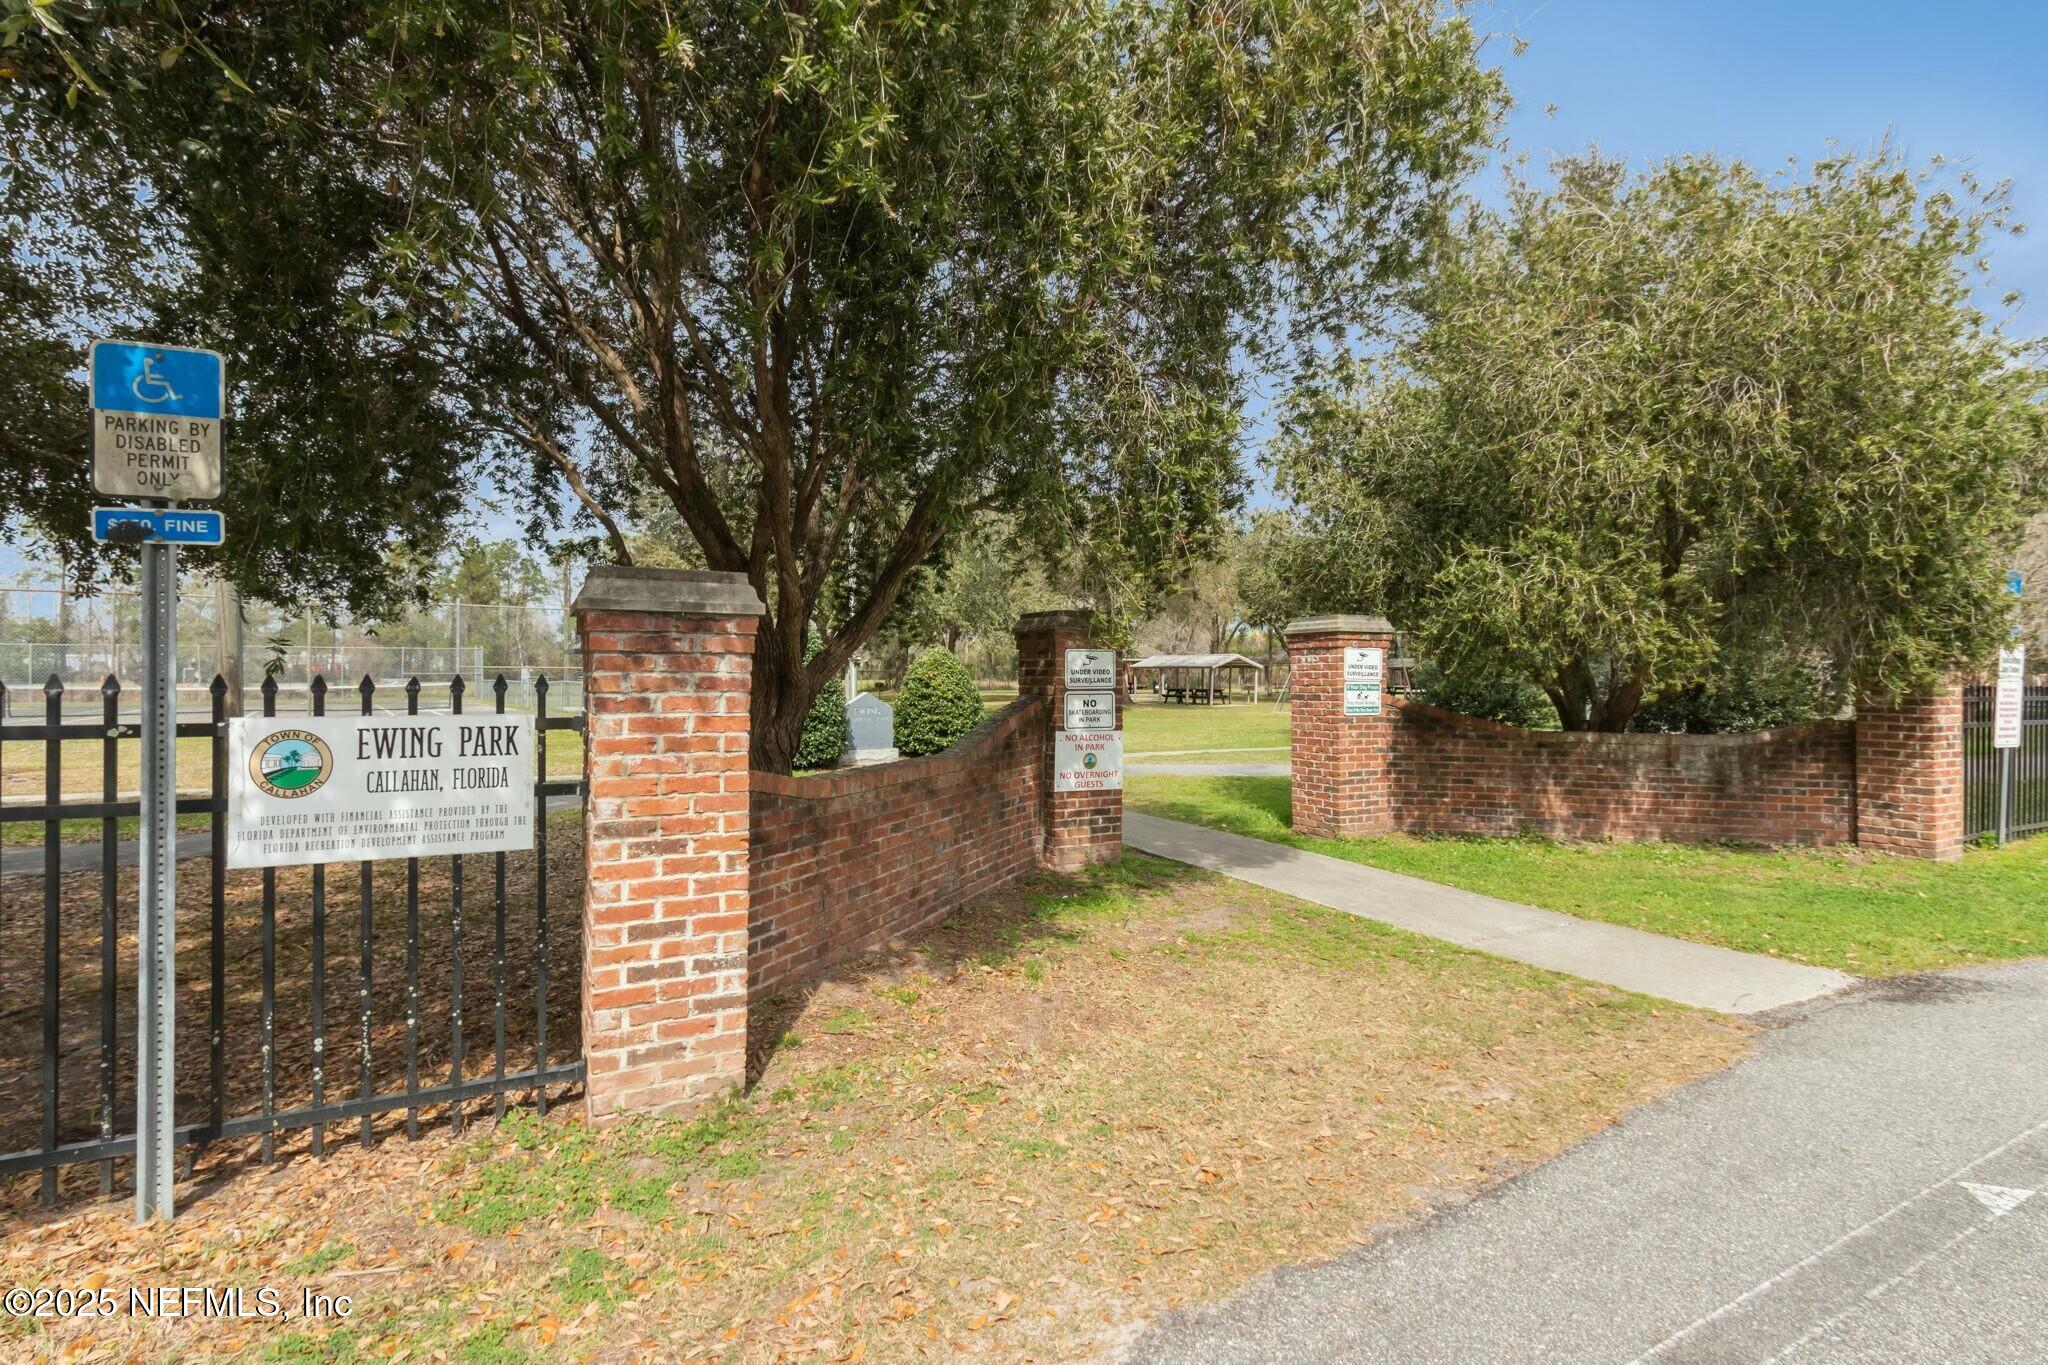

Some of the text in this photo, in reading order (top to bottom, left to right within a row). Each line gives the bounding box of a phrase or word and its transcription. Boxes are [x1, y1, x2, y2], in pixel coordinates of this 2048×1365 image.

[105, 415, 210, 437] PARKING BY
[116, 434, 200, 453] DISABLED
[127, 453, 190, 471] PERMIT
[165, 519, 208, 533] FINE
[1082, 700, 1097, 708] NO
[263, 731, 321, 746] TOWN OF
[356, 725, 519, 760] EWING PARK
[1065, 733, 1115, 742] NO ALCOHOL
[1074, 743, 1105, 752] IN PARK
[366, 767, 509, 794] CALLAHAN, FLORIDA
[1073, 770, 1118, 779] OVERNIGHT
[259, 779, 324, 797] CALLAHAN
[260, 804, 508, 826] DEVELOPED WITH FINANCIAL ASSISTANCE PROVIDED BY THE
[237, 815, 527, 841] FLORIDA DEPARTMENT OF ENVIRONMENTAL PROTECTION THROUGH THE
[263, 830, 505, 854] FLORIDA RECREATION DEVELOPMENT ASSISTANCE PROGRAM
